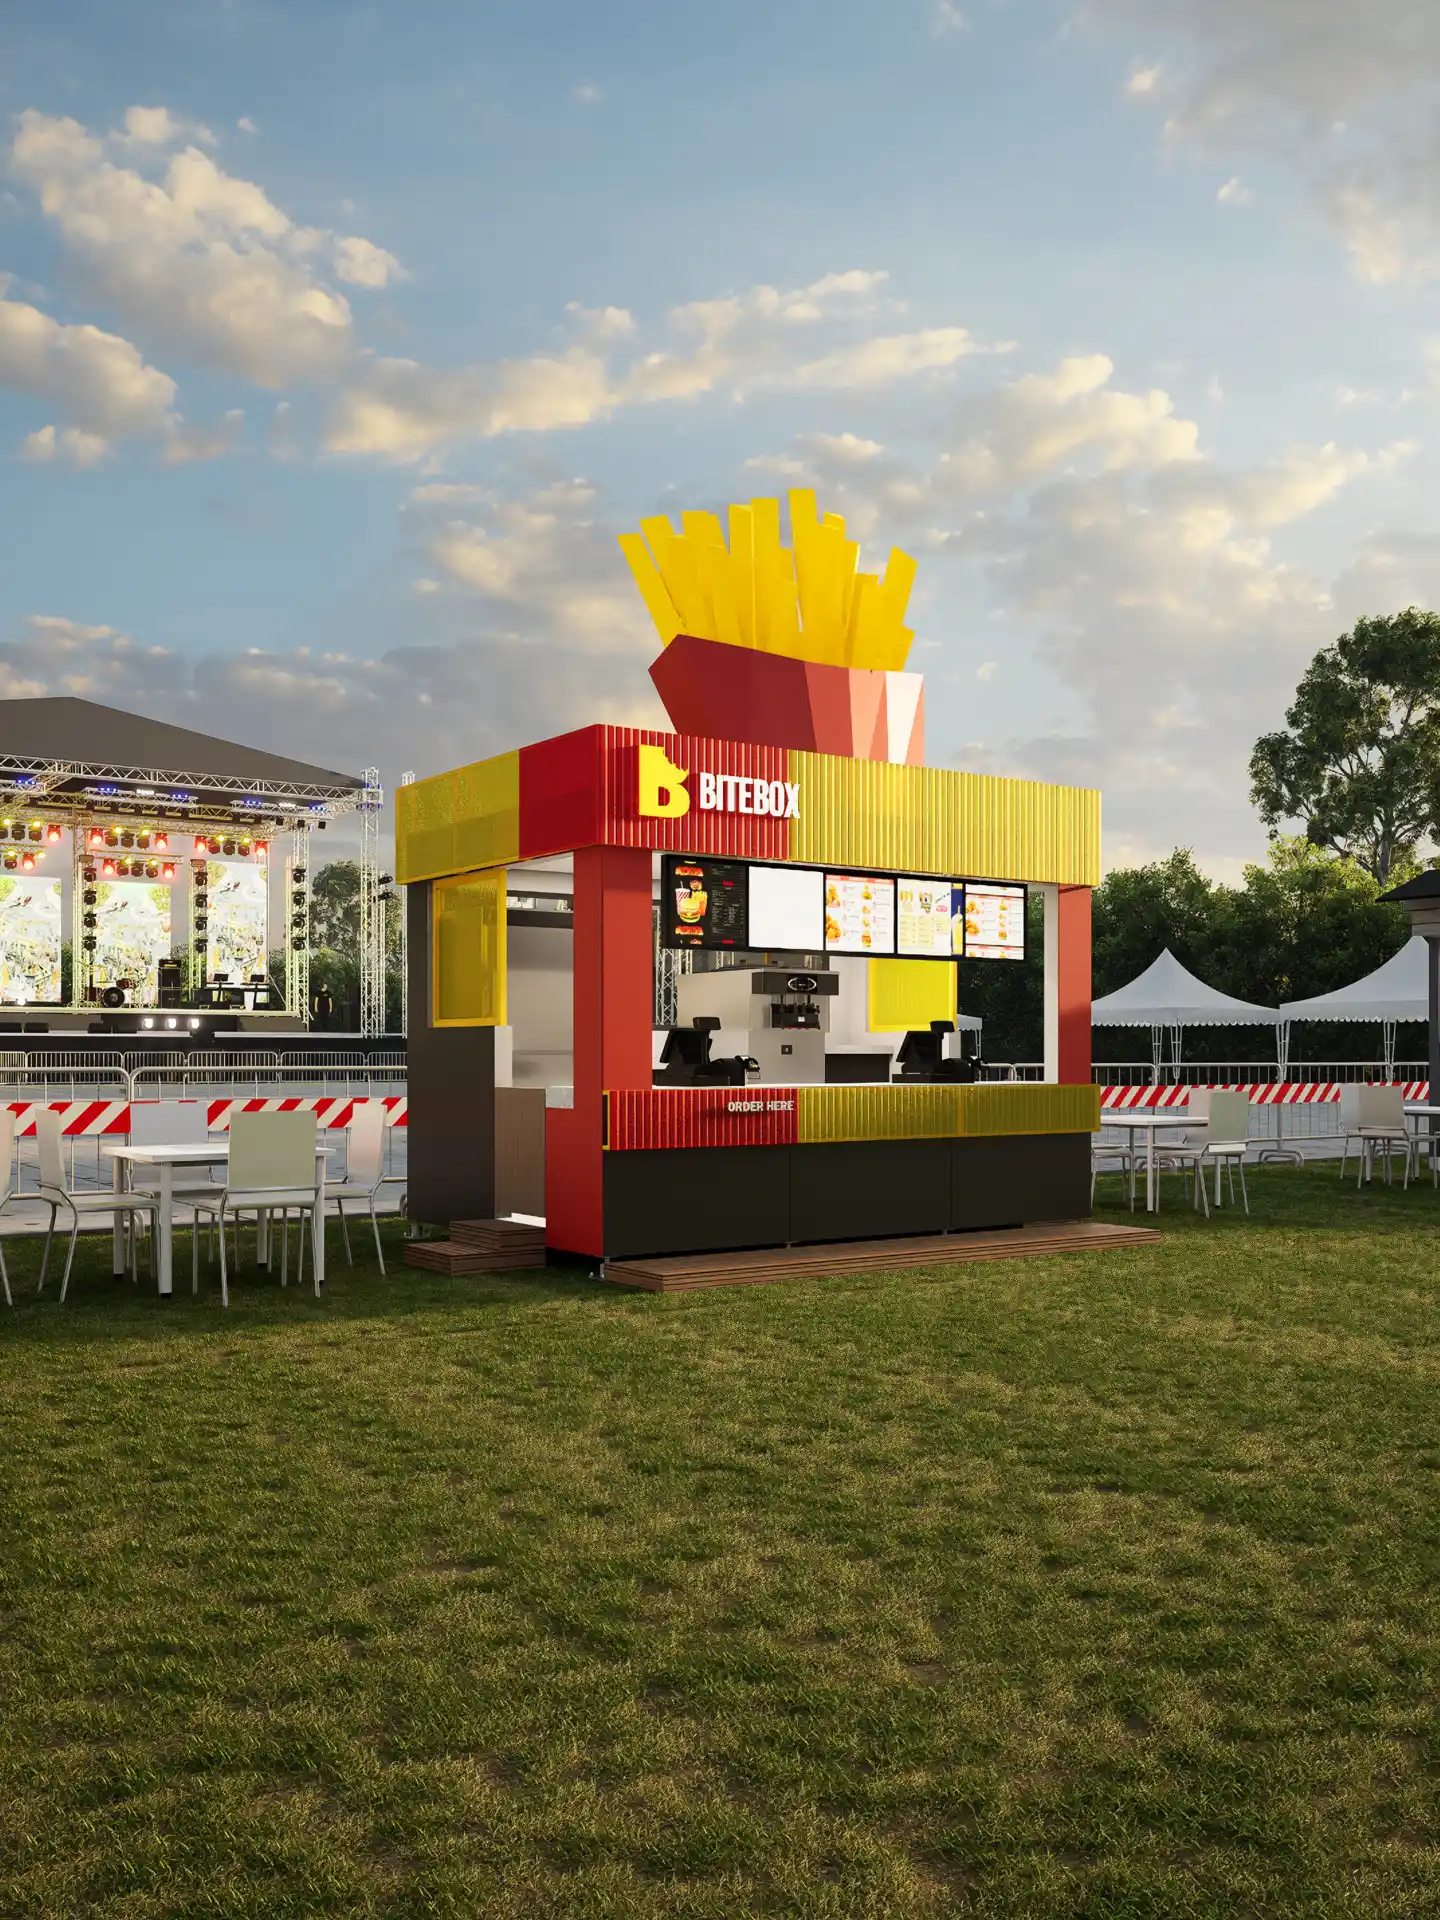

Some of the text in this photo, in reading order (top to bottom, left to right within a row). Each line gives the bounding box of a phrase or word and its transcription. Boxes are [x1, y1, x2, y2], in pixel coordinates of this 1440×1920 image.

[700, 772, 800, 818] BITEBOX
[728, 1100, 794, 1112] ORDER HERE
